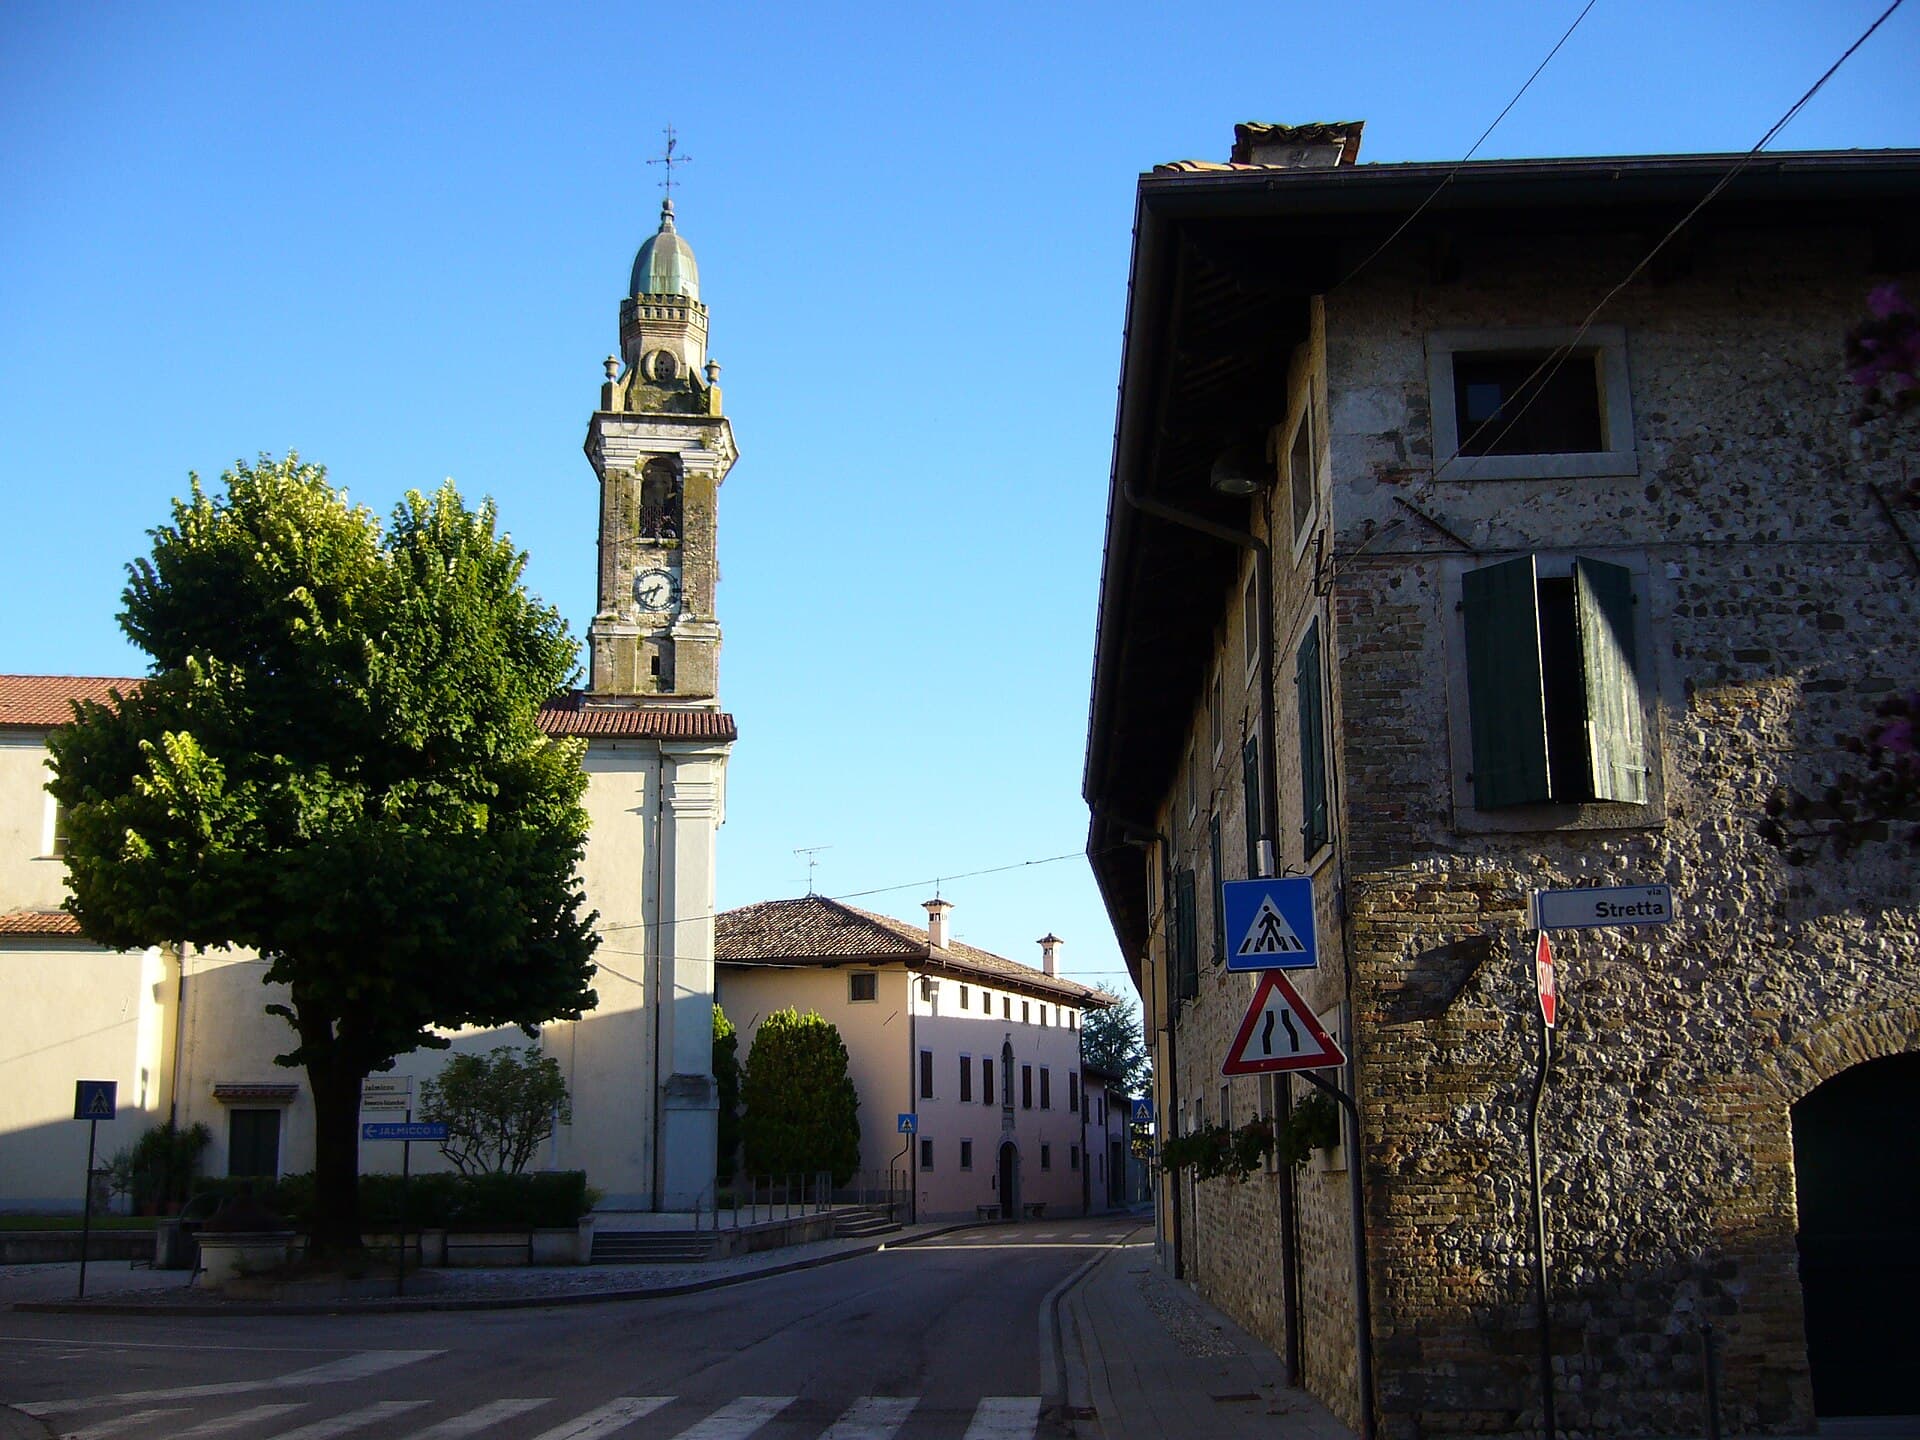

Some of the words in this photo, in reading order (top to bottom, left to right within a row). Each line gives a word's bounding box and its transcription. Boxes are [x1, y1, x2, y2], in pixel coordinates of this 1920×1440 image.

[1646, 888, 1662, 896] via
[1596, 902, 1664, 918] Stretta
[379, 1127, 431, 1135] JALMICCO
